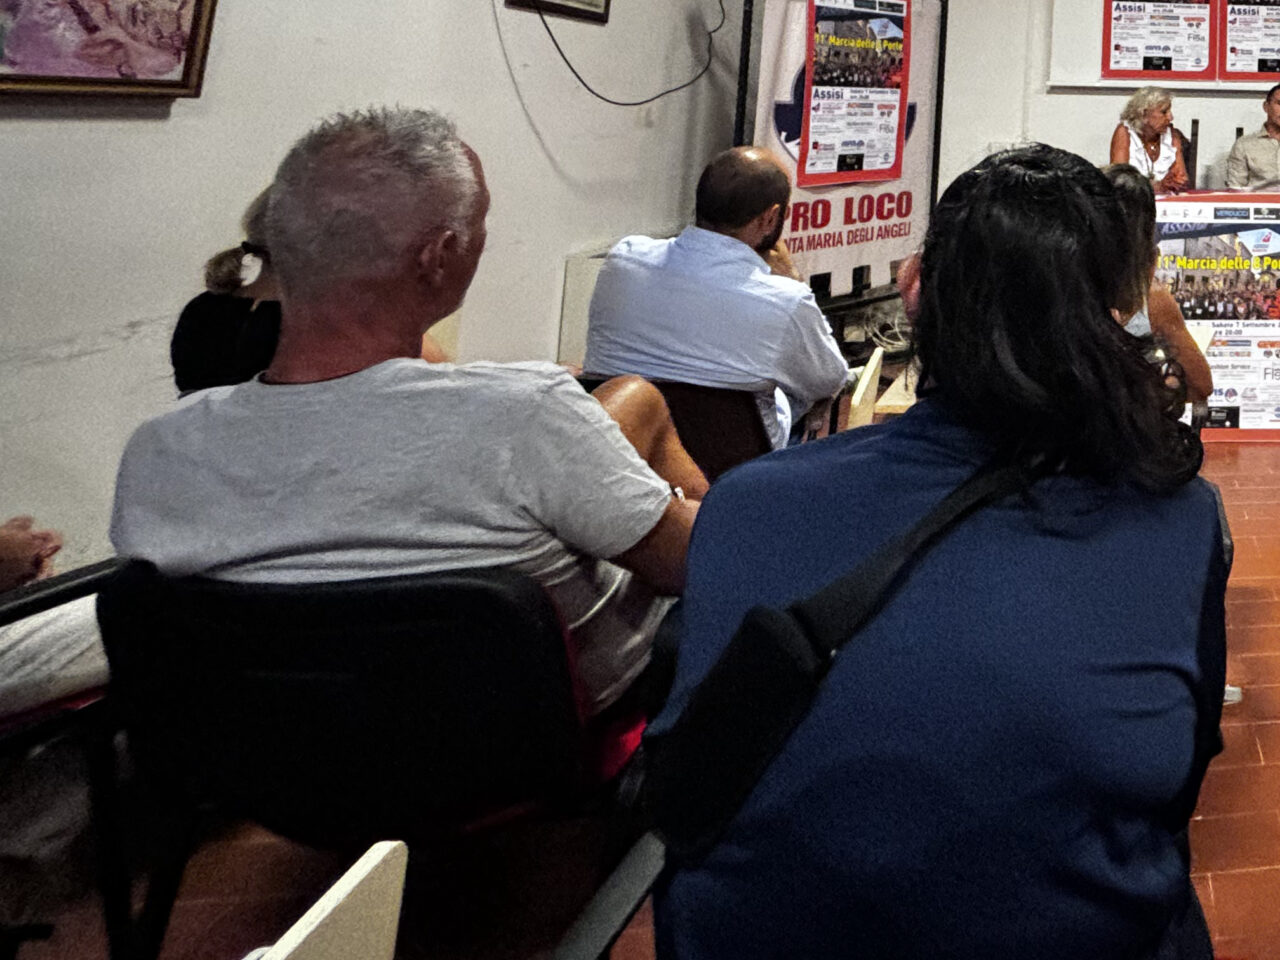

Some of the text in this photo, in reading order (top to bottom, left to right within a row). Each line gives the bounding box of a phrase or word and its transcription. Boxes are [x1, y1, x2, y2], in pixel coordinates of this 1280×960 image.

[1114, 3, 1146, 13] Assisi
[1229, 6, 1260, 16] Assisi
[828, 35, 855, 46] Marcia
[883, 40, 903, 51] Porte
[813, 88, 844, 100] Assisi
[843, 191, 913, 226] LOCO
[784, 222, 911, 254] NTA MARIA DEGLI ANGELI
[1176, 256, 1217, 270] Marcia
[1220, 256, 1250, 270] delle
